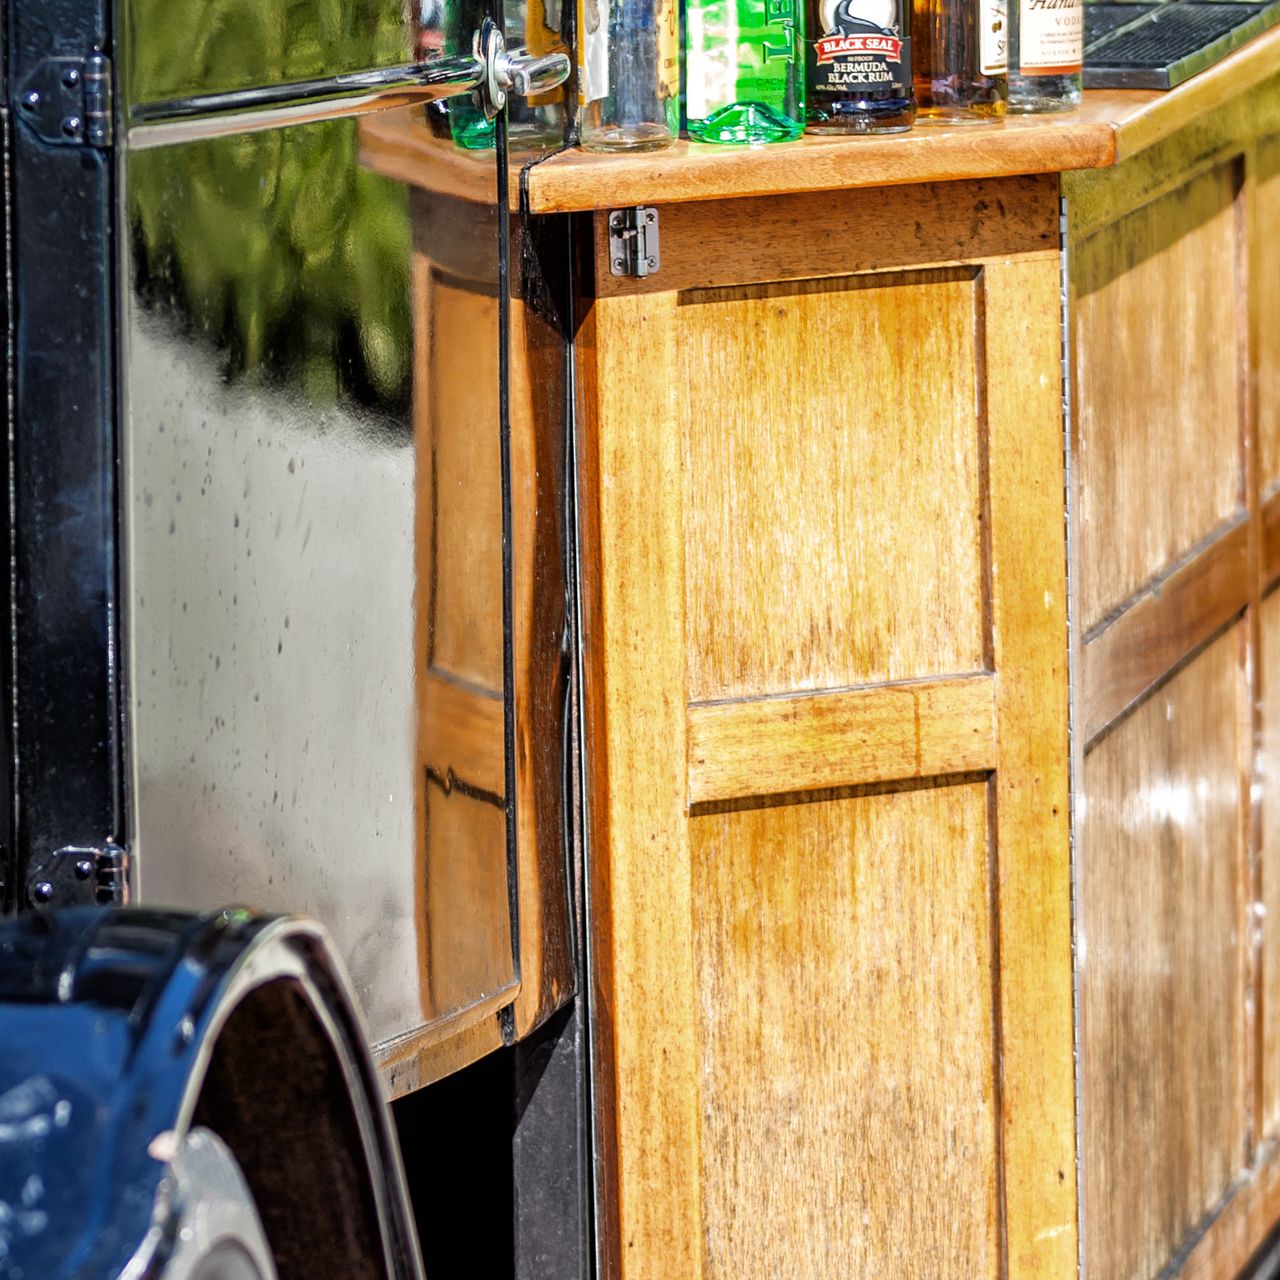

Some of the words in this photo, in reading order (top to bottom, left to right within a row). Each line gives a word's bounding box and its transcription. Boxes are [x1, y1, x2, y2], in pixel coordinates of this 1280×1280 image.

[823, 39, 862, 52] BLACK
[865, 38, 894, 50] SEAL
[833, 62, 888, 73] BERMUDA
[828, 72, 868, 83] BLACK
[869, 71, 893, 81] RUM
